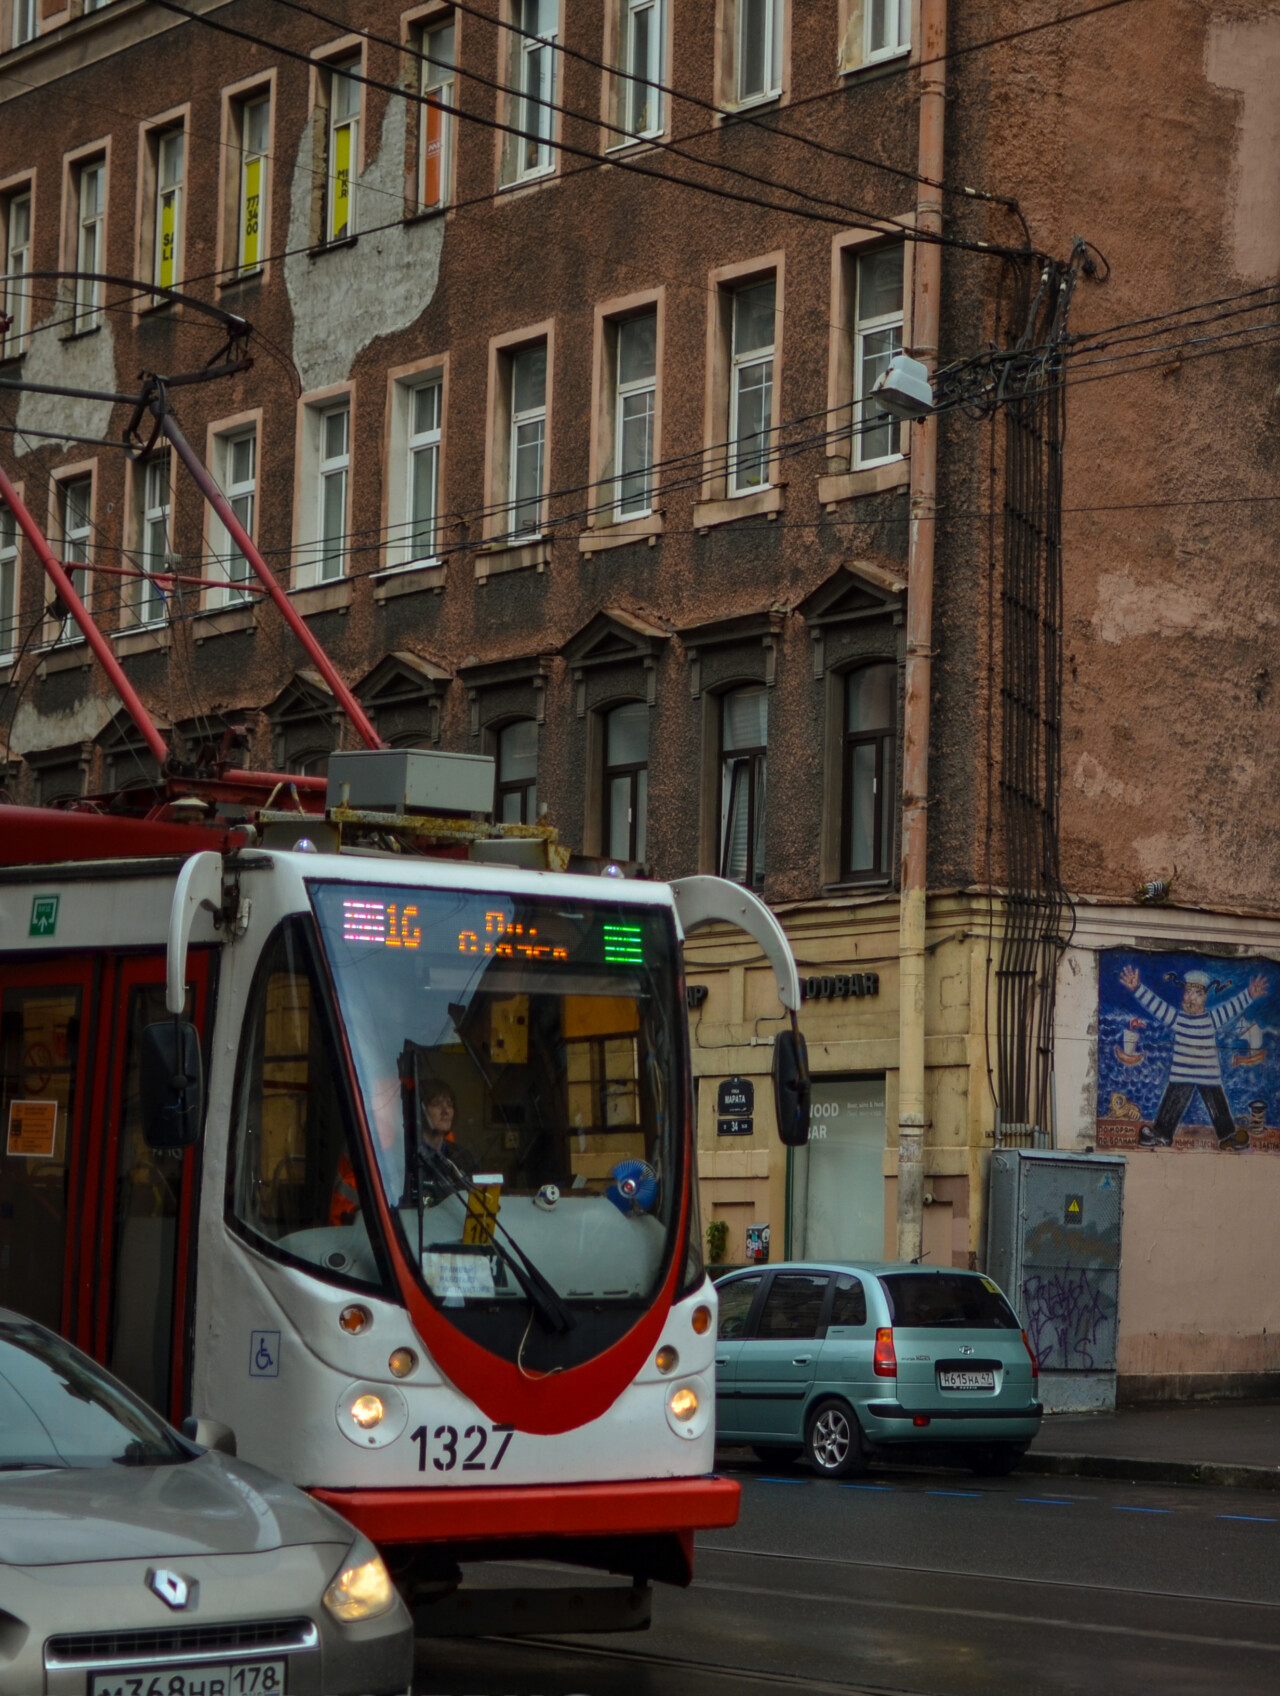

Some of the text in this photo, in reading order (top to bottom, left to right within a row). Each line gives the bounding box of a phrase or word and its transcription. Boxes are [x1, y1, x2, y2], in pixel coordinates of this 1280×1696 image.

[809, 1103, 839, 1118] OOD
[731, 1120, 739, 1132] 34
[410, 1425, 515, 1471] 1327
[233, 1666, 276, 1692] 178
